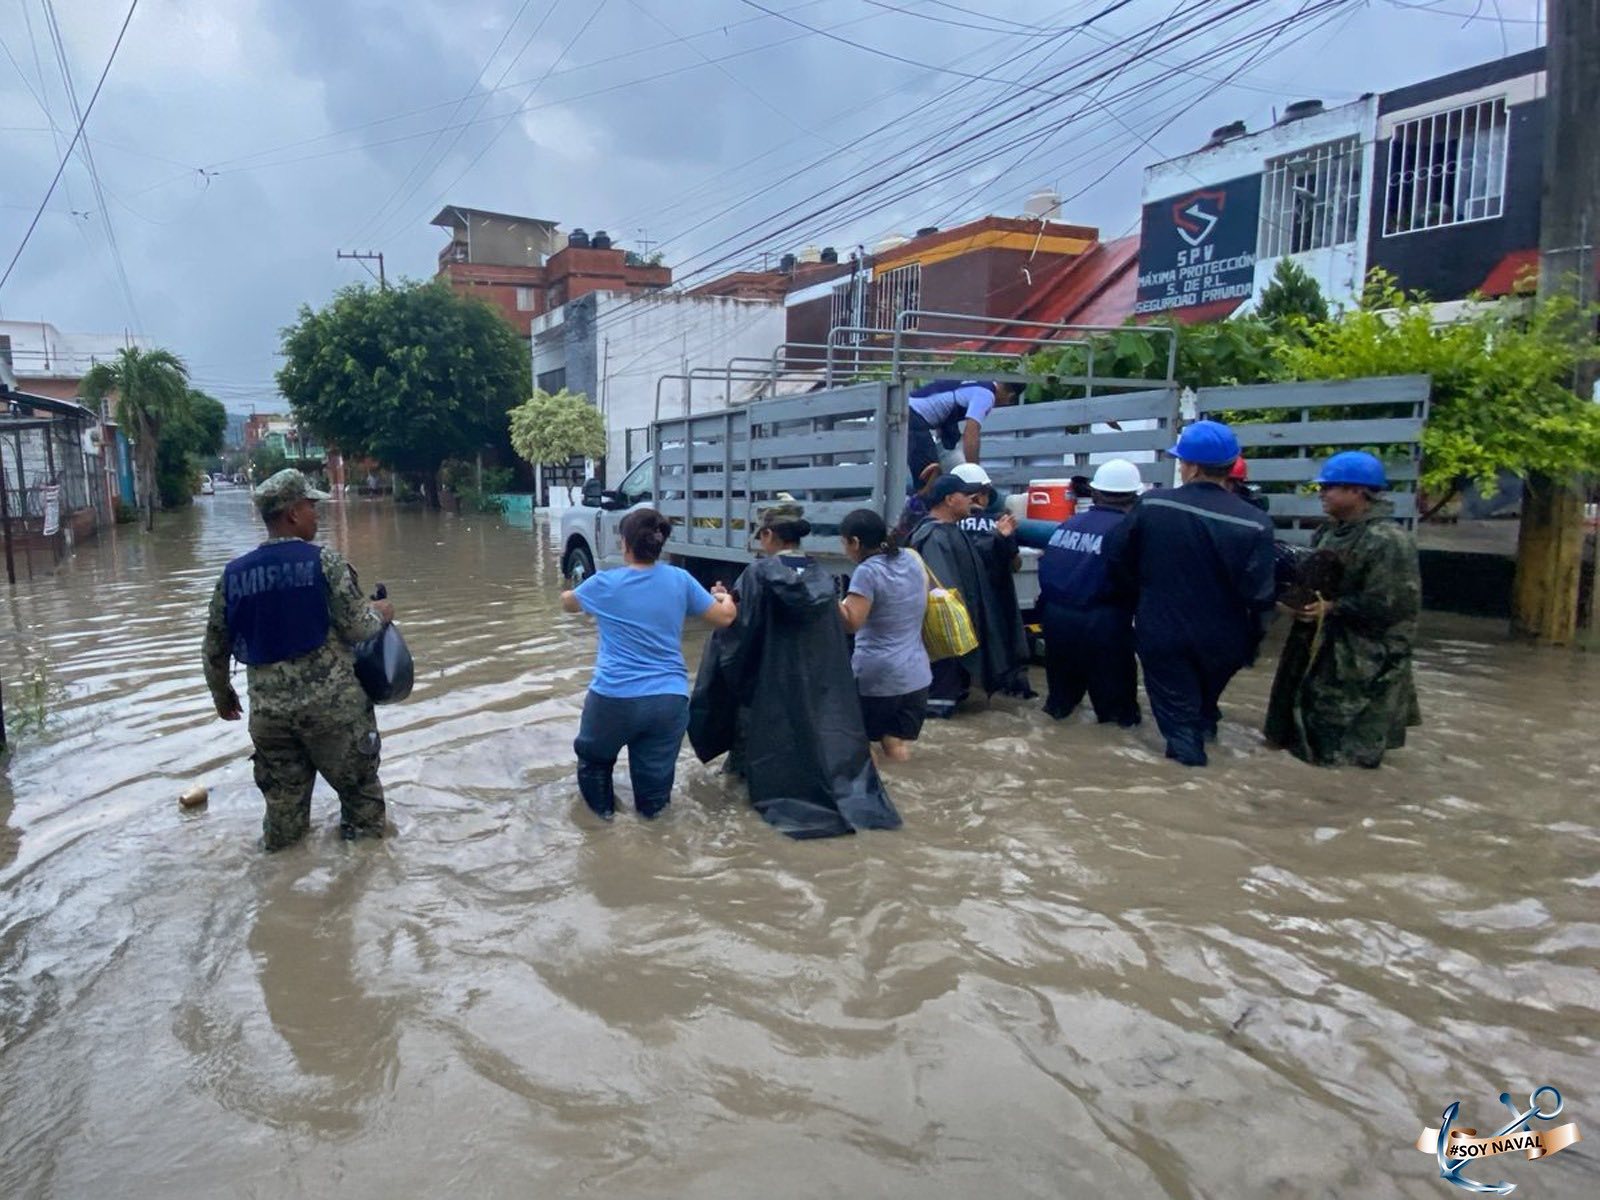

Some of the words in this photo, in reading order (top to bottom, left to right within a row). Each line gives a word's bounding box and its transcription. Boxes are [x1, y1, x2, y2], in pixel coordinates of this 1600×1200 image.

[1179, 251, 1256, 280] PROTECCIÓN
[1183, 279, 1200, 293] DE
[1201, 282, 1253, 303] PRIVADA
[1048, 529, 1103, 555] MARINA
